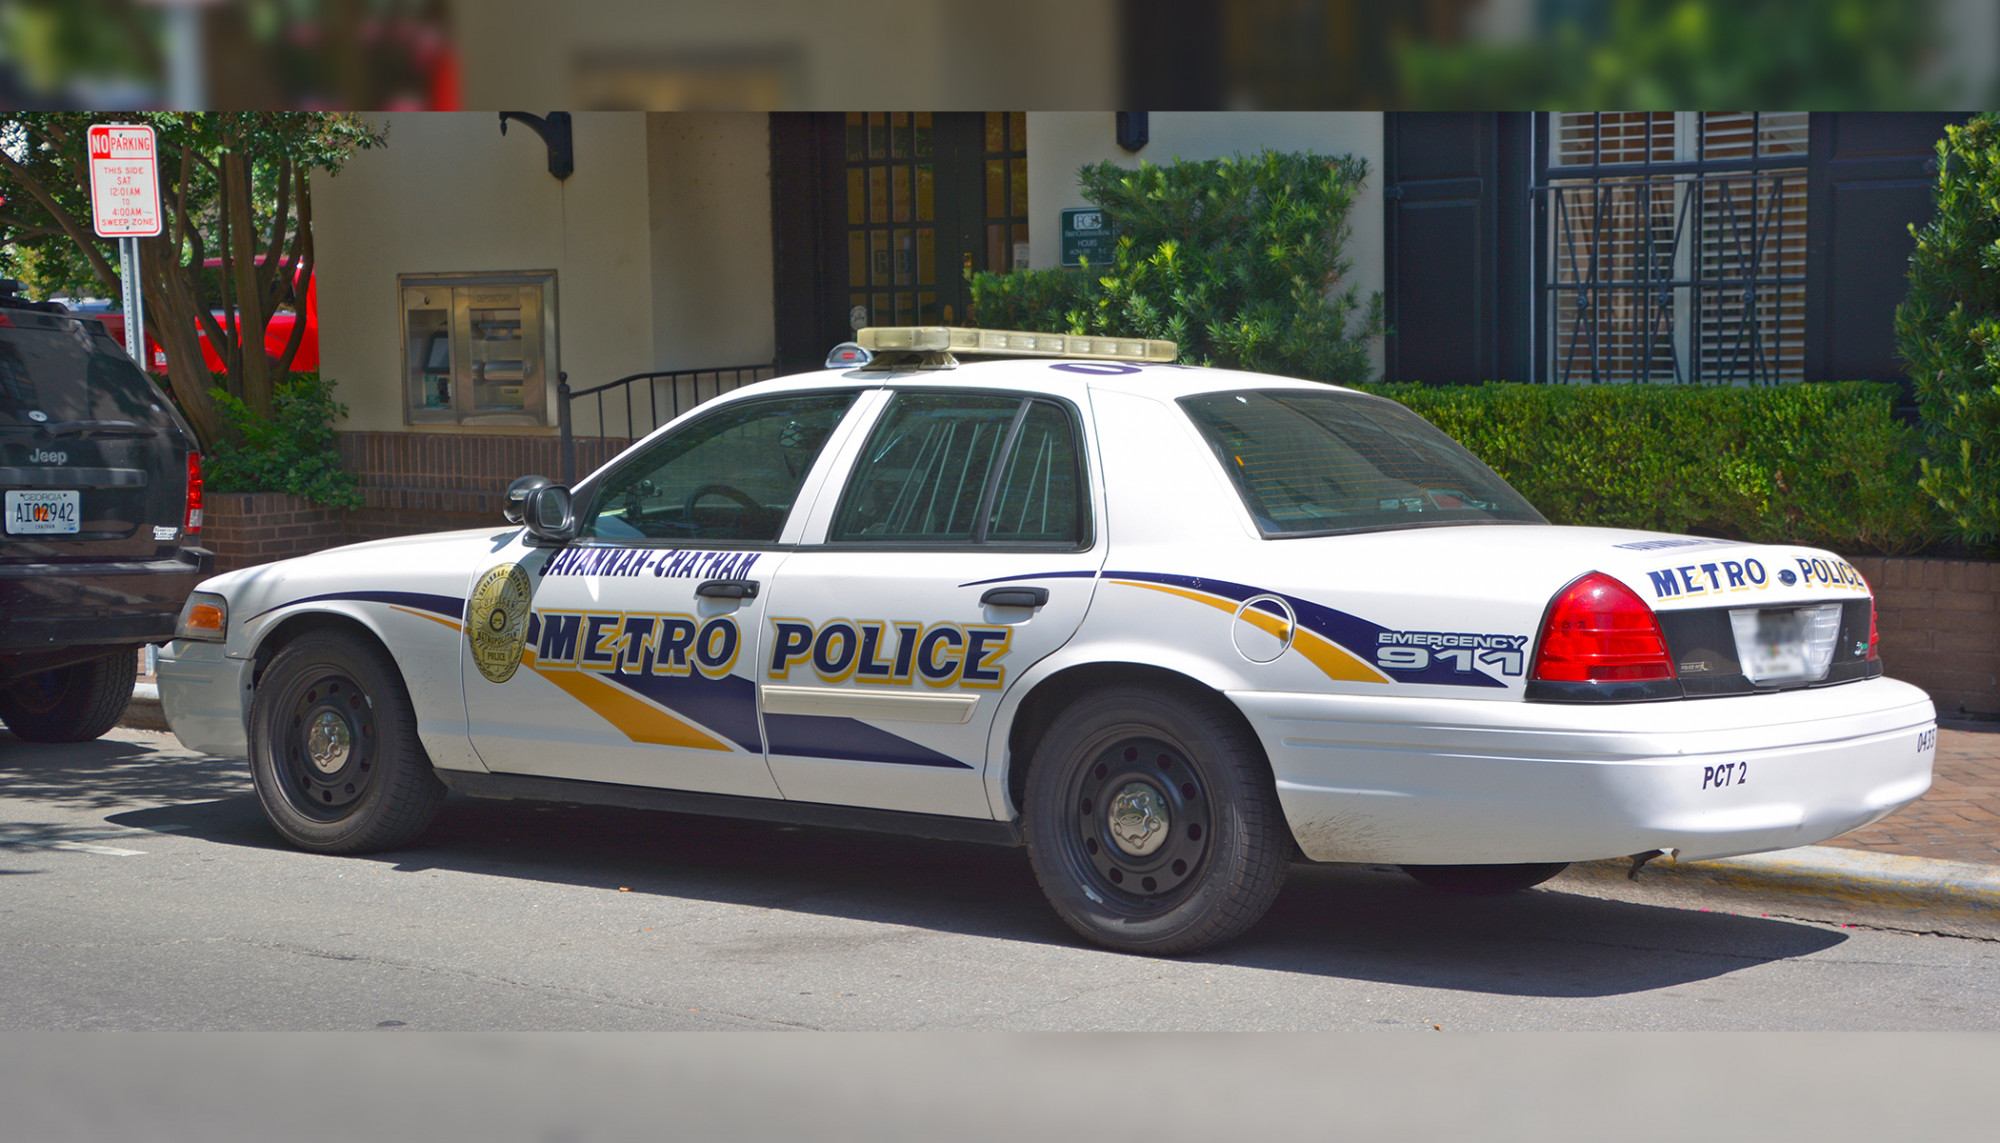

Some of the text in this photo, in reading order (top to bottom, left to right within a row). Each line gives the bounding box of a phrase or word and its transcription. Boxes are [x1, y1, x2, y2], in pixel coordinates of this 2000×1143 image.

[92, 134, 150, 154] NO PARKING
[104, 166, 143, 174] THIS SIDE
[117, 176, 131, 185] SAT
[110, 187, 141, 196] 12:01AM
[112, 208, 142, 216] 4:00AM
[102, 218, 154, 227] SWEEP ZONE
[29, 448, 68, 465] Jeep
[23, 493, 62, 501] GEORGIA
[1646, 558, 1867, 601] METRO POLICE
[1378, 632, 1525, 650] EMERGENCY
[537, 610, 1013, 688] METRO POLICE
[487, 651, 506, 661] POLICE
[1377, 646, 1522, 675] 911
[1702, 761, 1747, 790] PCT 2
